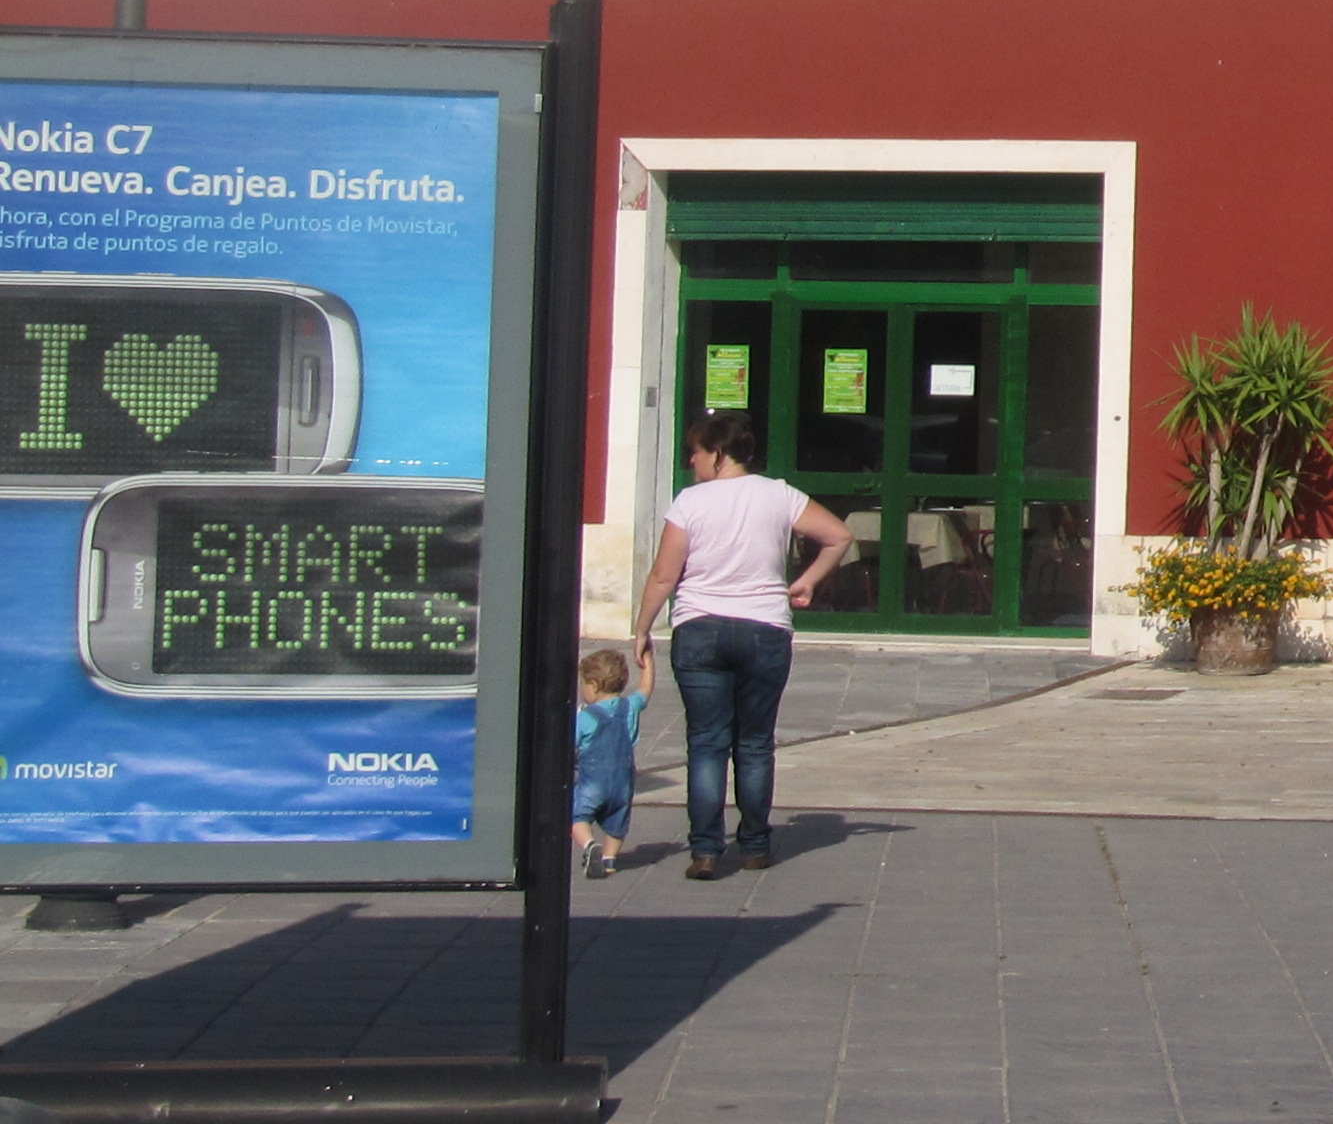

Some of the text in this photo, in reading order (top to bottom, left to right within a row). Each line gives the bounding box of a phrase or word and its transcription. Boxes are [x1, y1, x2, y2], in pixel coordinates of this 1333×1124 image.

[0, 121, 154, 155] Nokia C7
[0, 161, 465, 206] Renueva. Canjea. Disfruta.
[0, 206, 459, 237] hora, con el Programa de Puntos de Movistar,
[0, 230, 284, 259] isfruta de puntos de regalo.
[191, 523, 443, 583] SMART
[133, 559, 146, 610] NOKIA
[162, 589, 468, 651] PHONES
[15, 760, 118, 779] movistar
[327, 752, 440, 772] NOKIA
[327, 773, 438, 789] Connecting People
